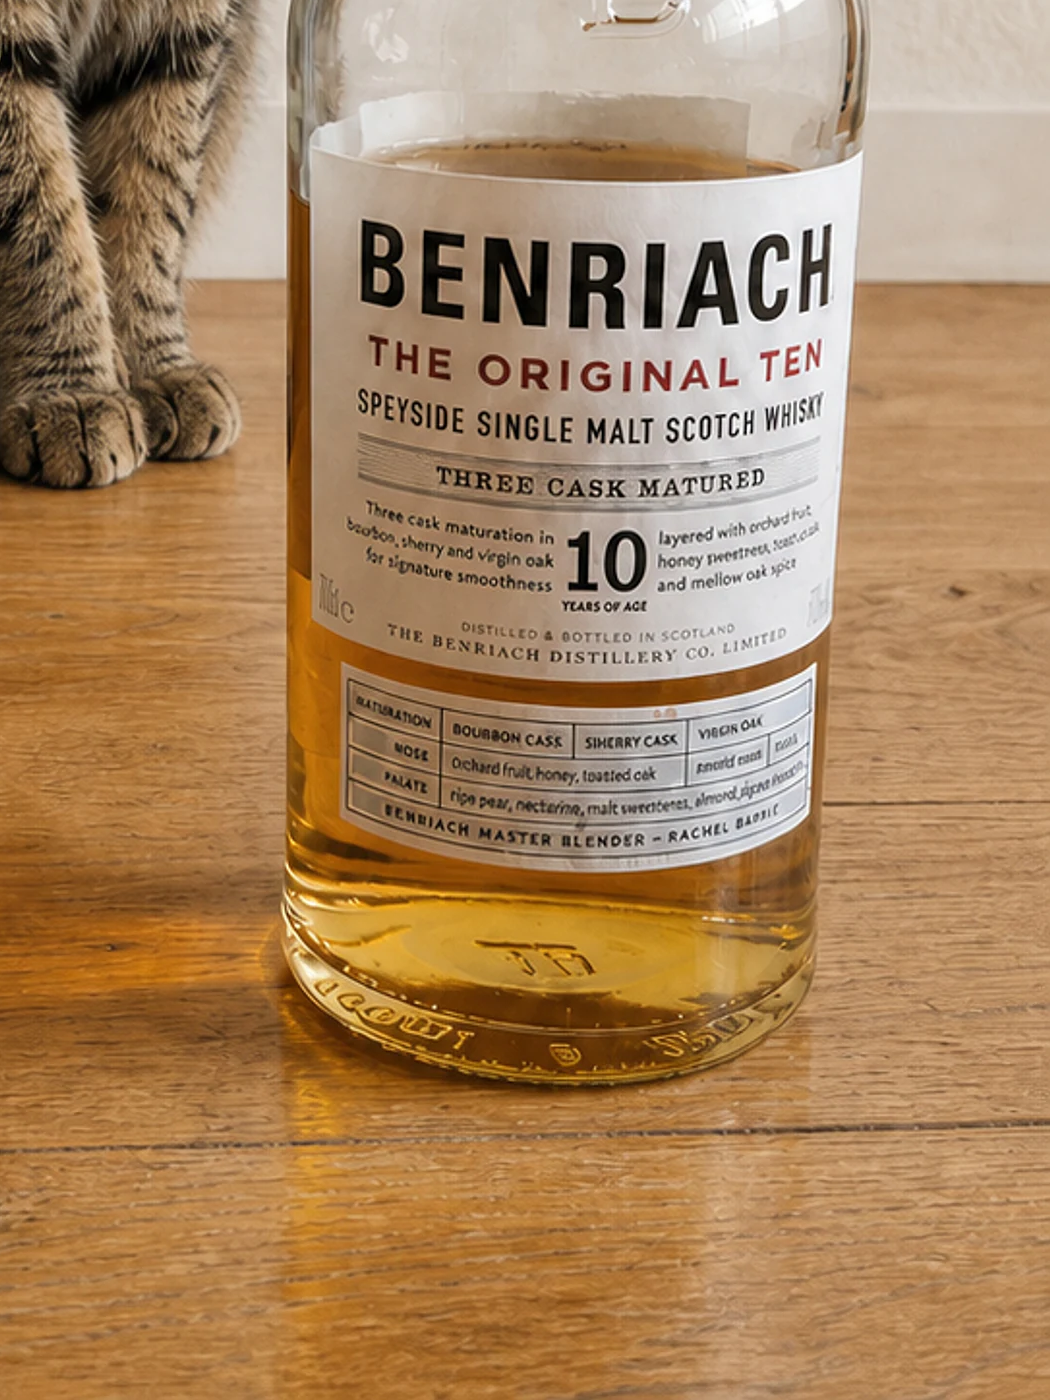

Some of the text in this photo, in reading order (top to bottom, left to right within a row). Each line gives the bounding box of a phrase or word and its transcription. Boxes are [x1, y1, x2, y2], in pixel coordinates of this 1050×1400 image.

[360, 218, 832, 329] BENRIACH
[368, 334, 823, 393] THE ORIGINAL TEN
[357, 388, 825, 445] SPEYSIDE SINGLE MALT SCOTCH WHISKY
[436, 465, 766, 499] THREE CASK MATURED
[366, 500, 554, 545] Three cask maturation in
[658, 526, 714, 549] layered
[717, 521, 746, 540] with
[402, 535, 445, 559] sherry
[447, 543, 473, 561] and
[478, 549, 521, 569] virgin
[526, 553, 554, 568] oak
[567, 529, 647, 593] 10
[657, 552, 703, 570] honey
[366, 546, 552, 593] for signature smoothness
[657, 576, 686, 593] and
[691, 570, 744, 591] mellow
[746, 564, 767, 583] oak
[562, 601, 601, 613] YEARS
[623, 600, 648, 613] AGE
[387, 623, 787, 666] THE BENRIACH DISTILLERY CO. LIMITED
[461, 621, 736, 644] DISTILLED & BOTTLED IN SCOTLAND
[356, 695, 432, 729] MATURATION
[394, 742, 429, 762] NOSE
[384, 771, 428, 795] PALATE
[384, 803, 470, 838] BENRIACH
[478, 827, 552, 847] MASTER
[561, 833, 646, 849] BLENDER
[668, 822, 729, 844] RACHEL
